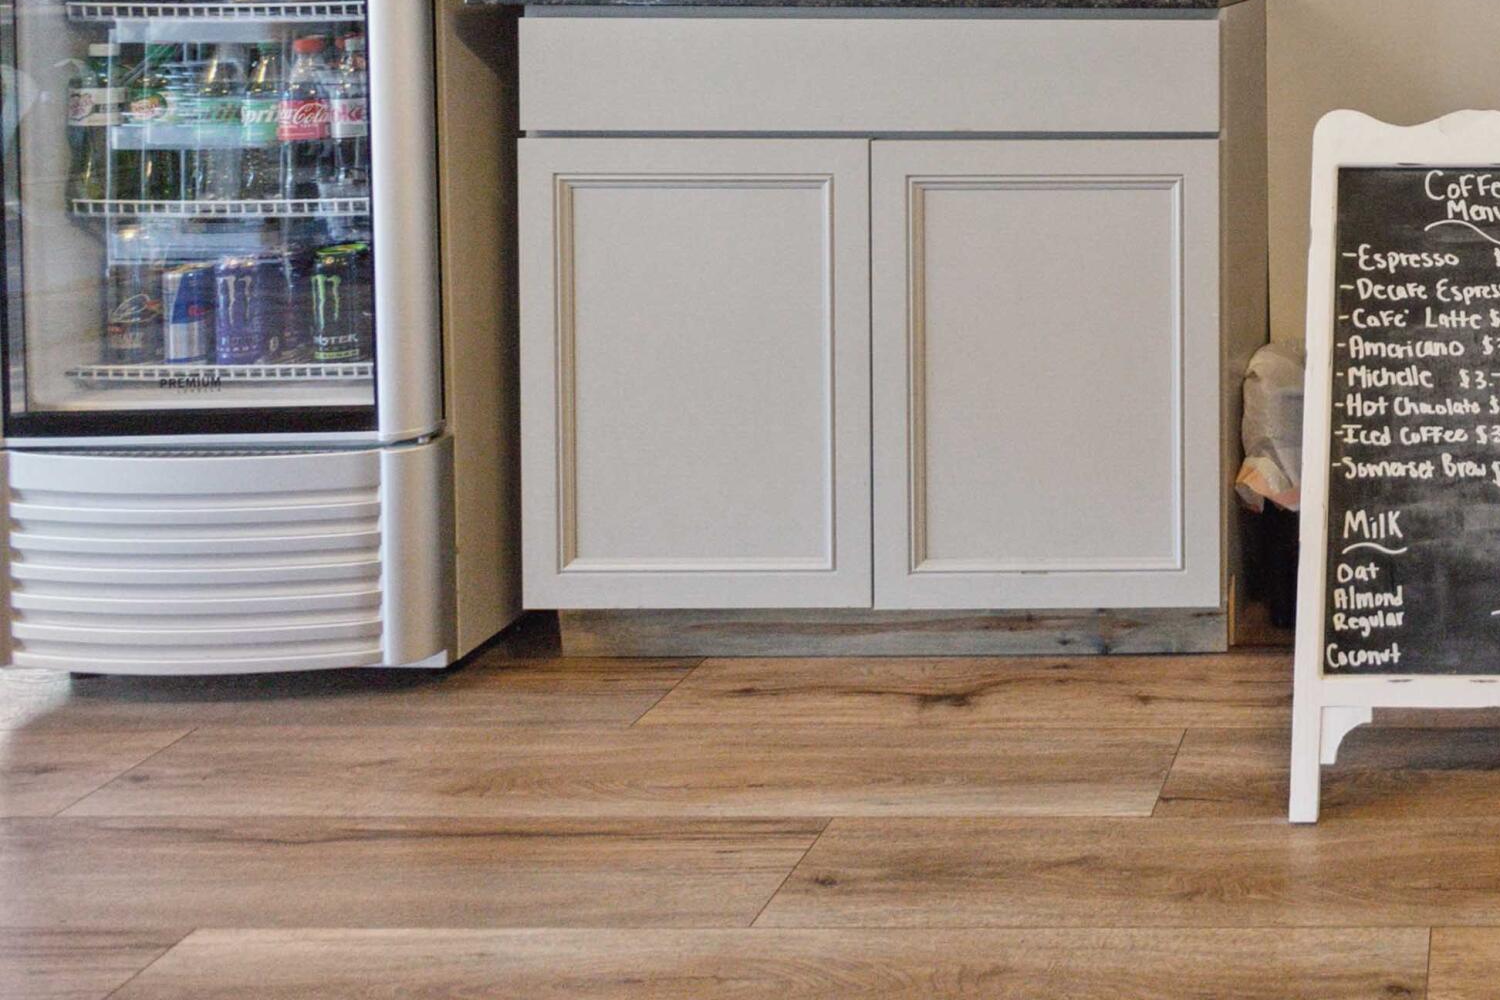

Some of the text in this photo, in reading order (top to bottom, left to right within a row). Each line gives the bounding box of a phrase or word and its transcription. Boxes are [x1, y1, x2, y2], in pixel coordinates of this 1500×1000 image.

[1358, 244, 1460, 273] Espresso
[1425, 306, 1482, 330] Latte
[1349, 335, 1465, 359] Americano
[160, 377, 222, 389] PREMIUM
[1348, 365, 1434, 388] Michelle
[1346, 393, 1389, 417] Hot
[1342, 424, 1391, 446] Iced
[1344, 457, 1434, 479] Somerset
[1441, 453, 1487, 478] Brew
[1337, 563, 1380, 583] Oat
[1333, 585, 1404, 610] Almond
[1333, 611, 1405, 637] Regular
[1326, 643, 1402, 668] Coconut
